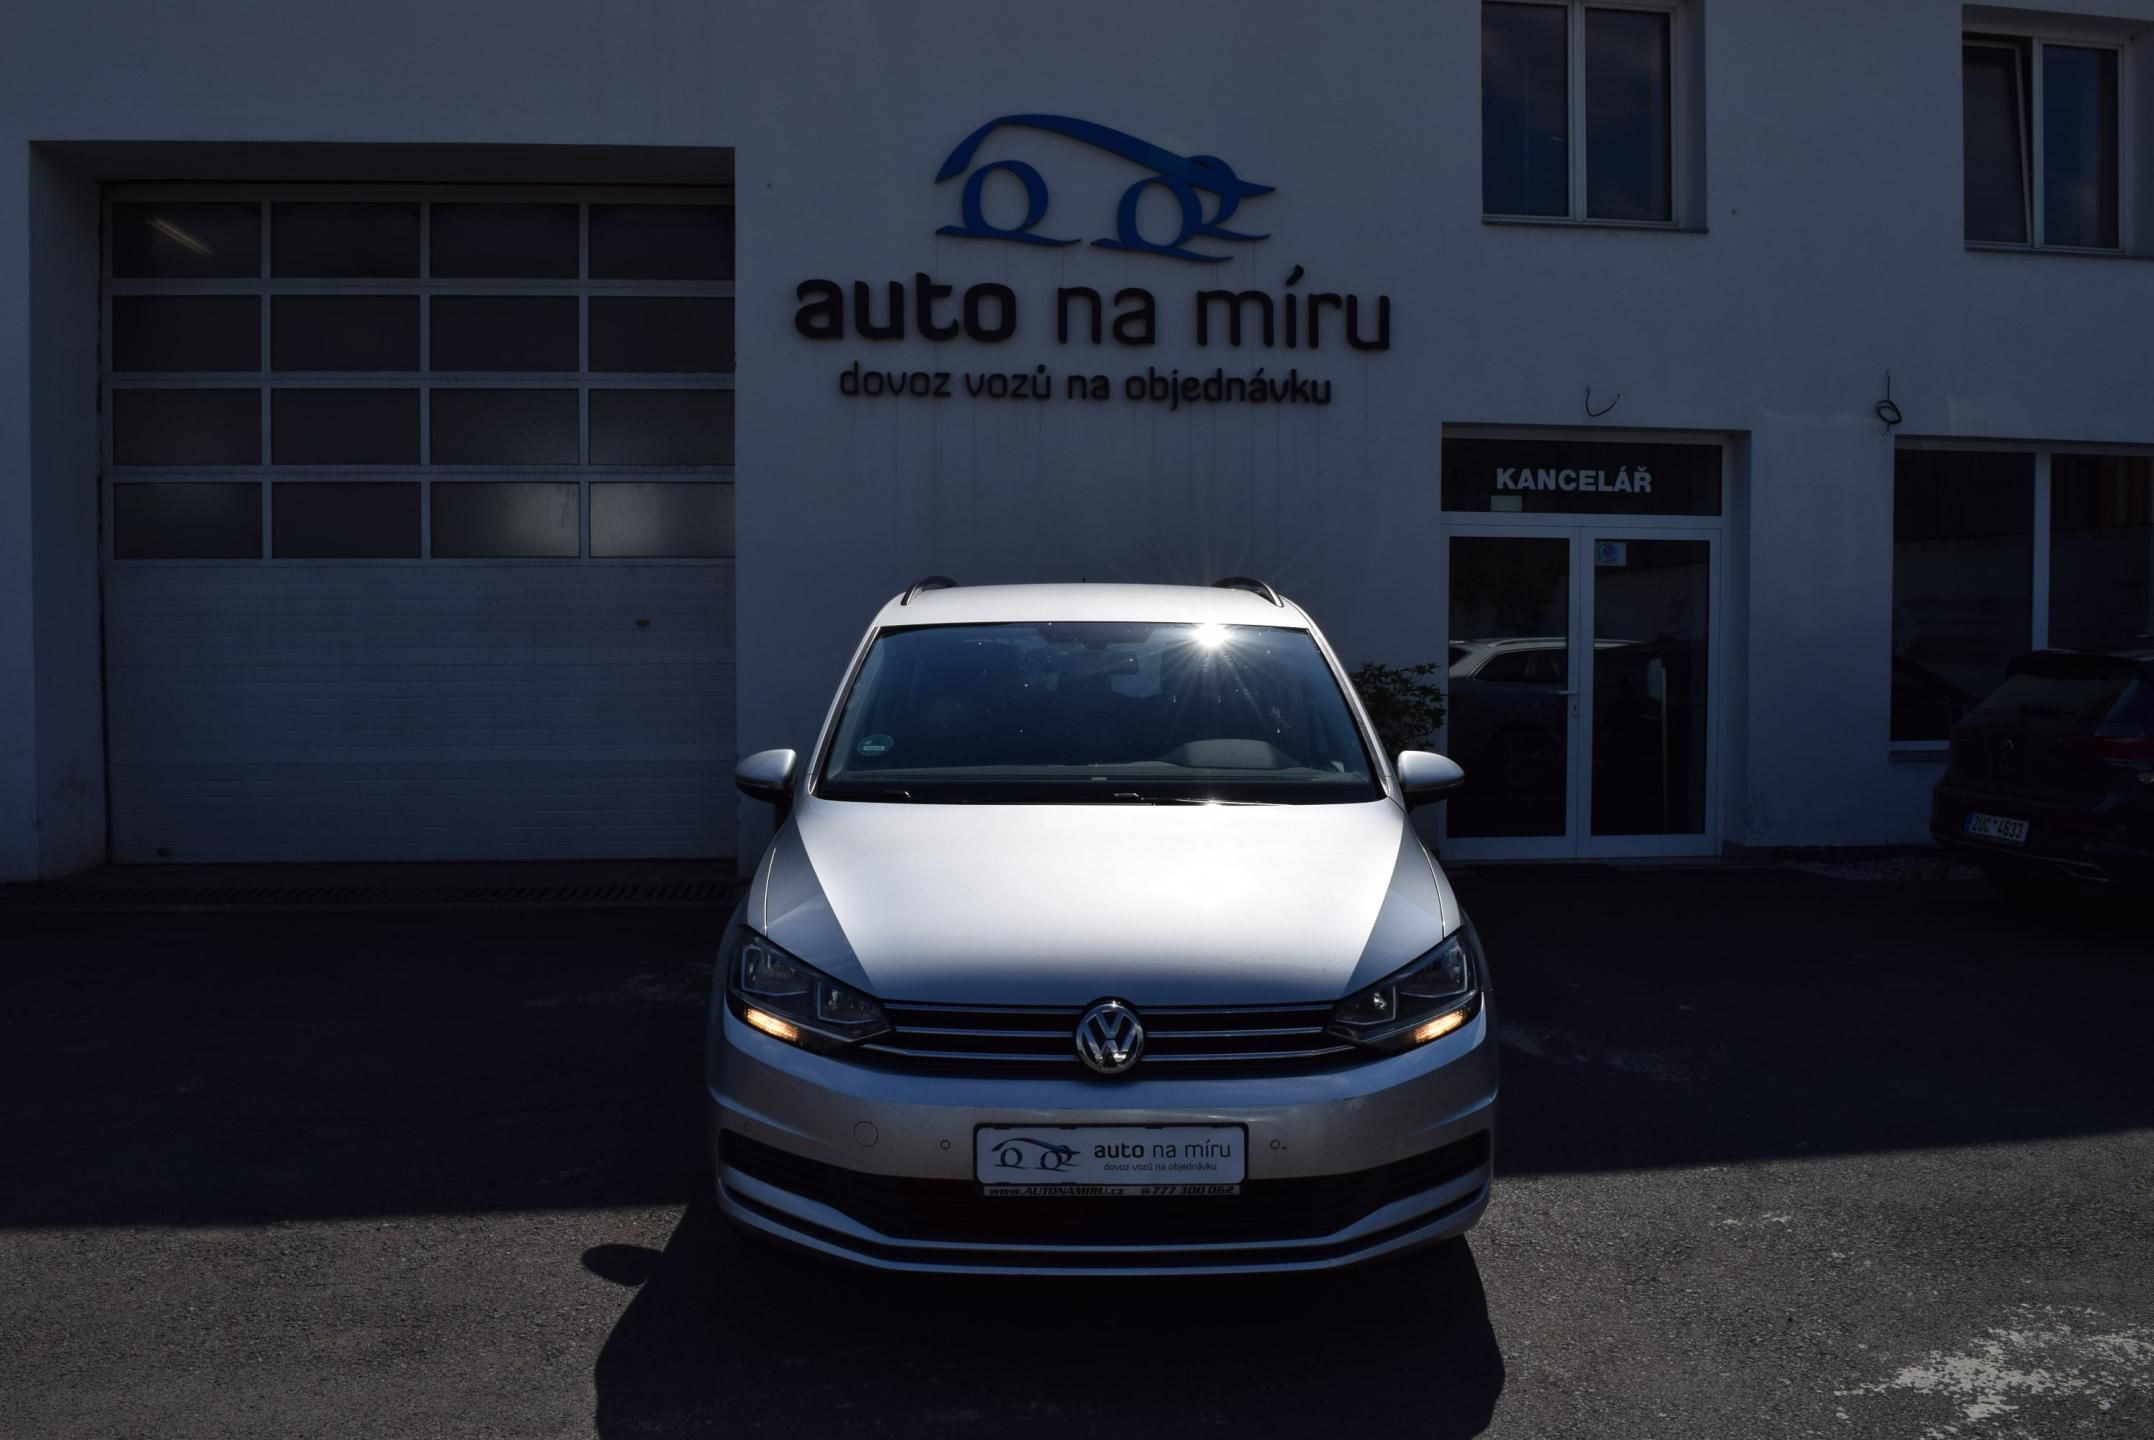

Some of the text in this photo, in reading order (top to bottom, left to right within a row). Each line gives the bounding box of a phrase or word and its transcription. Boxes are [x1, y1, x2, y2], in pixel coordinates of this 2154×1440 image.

[795, 264, 1390, 350] auto na míru
[840, 360, 1331, 411] dovoz vozů na objednávku
[1496, 465, 1653, 494] KANCELÁŘ
[1093, 1138, 1231, 1159] auto na míru
[1103, 1162, 1130, 1171] dovoz
[1132, 1162, 1153, 1171] vozů
[1168, 1162, 1217, 1173] objednávku
